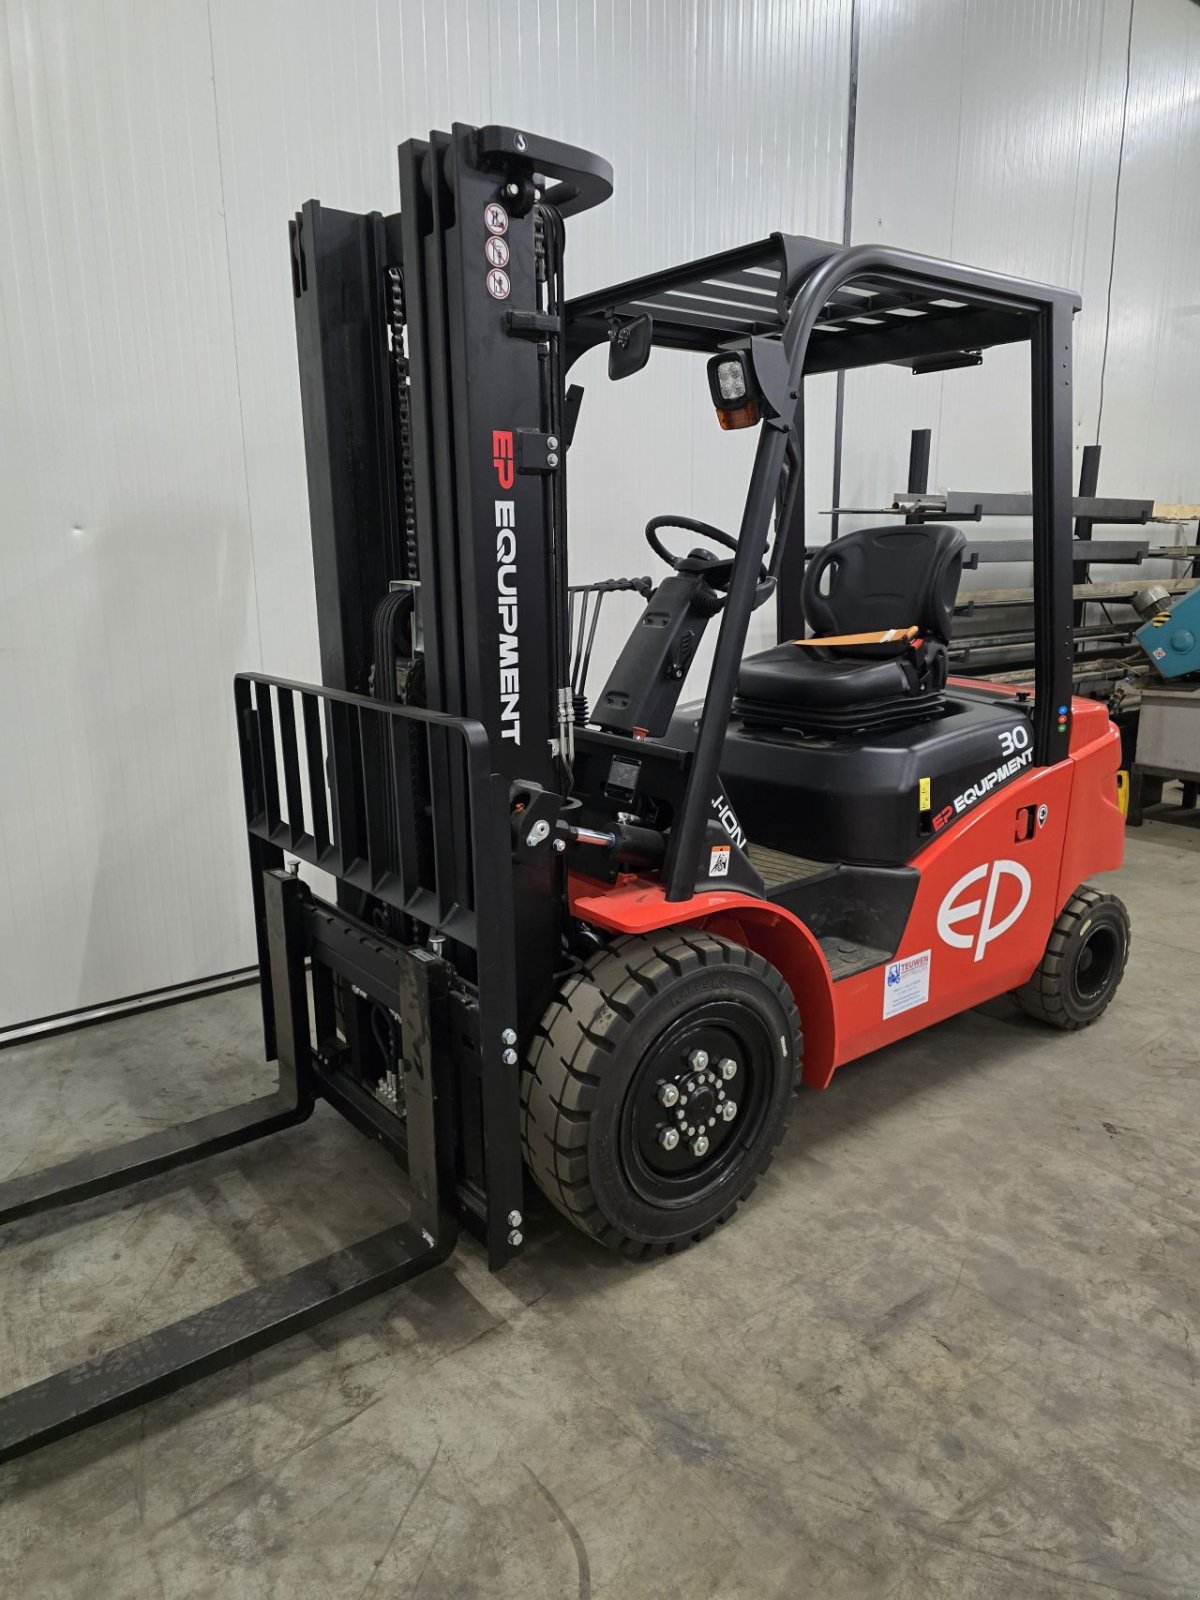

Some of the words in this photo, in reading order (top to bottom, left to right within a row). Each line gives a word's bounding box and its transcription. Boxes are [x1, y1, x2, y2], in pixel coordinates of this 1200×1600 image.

[493, 430, 515, 490] EP
[494, 499, 521, 746] EQUIPMENT
[998, 725, 1028, 757] 30
[932, 805, 954, 832] EP
[953, 746, 1034, 814] EQUIPMENT
[937, 859, 1032, 963] EP
[901, 955, 929, 971] TEUWEN
